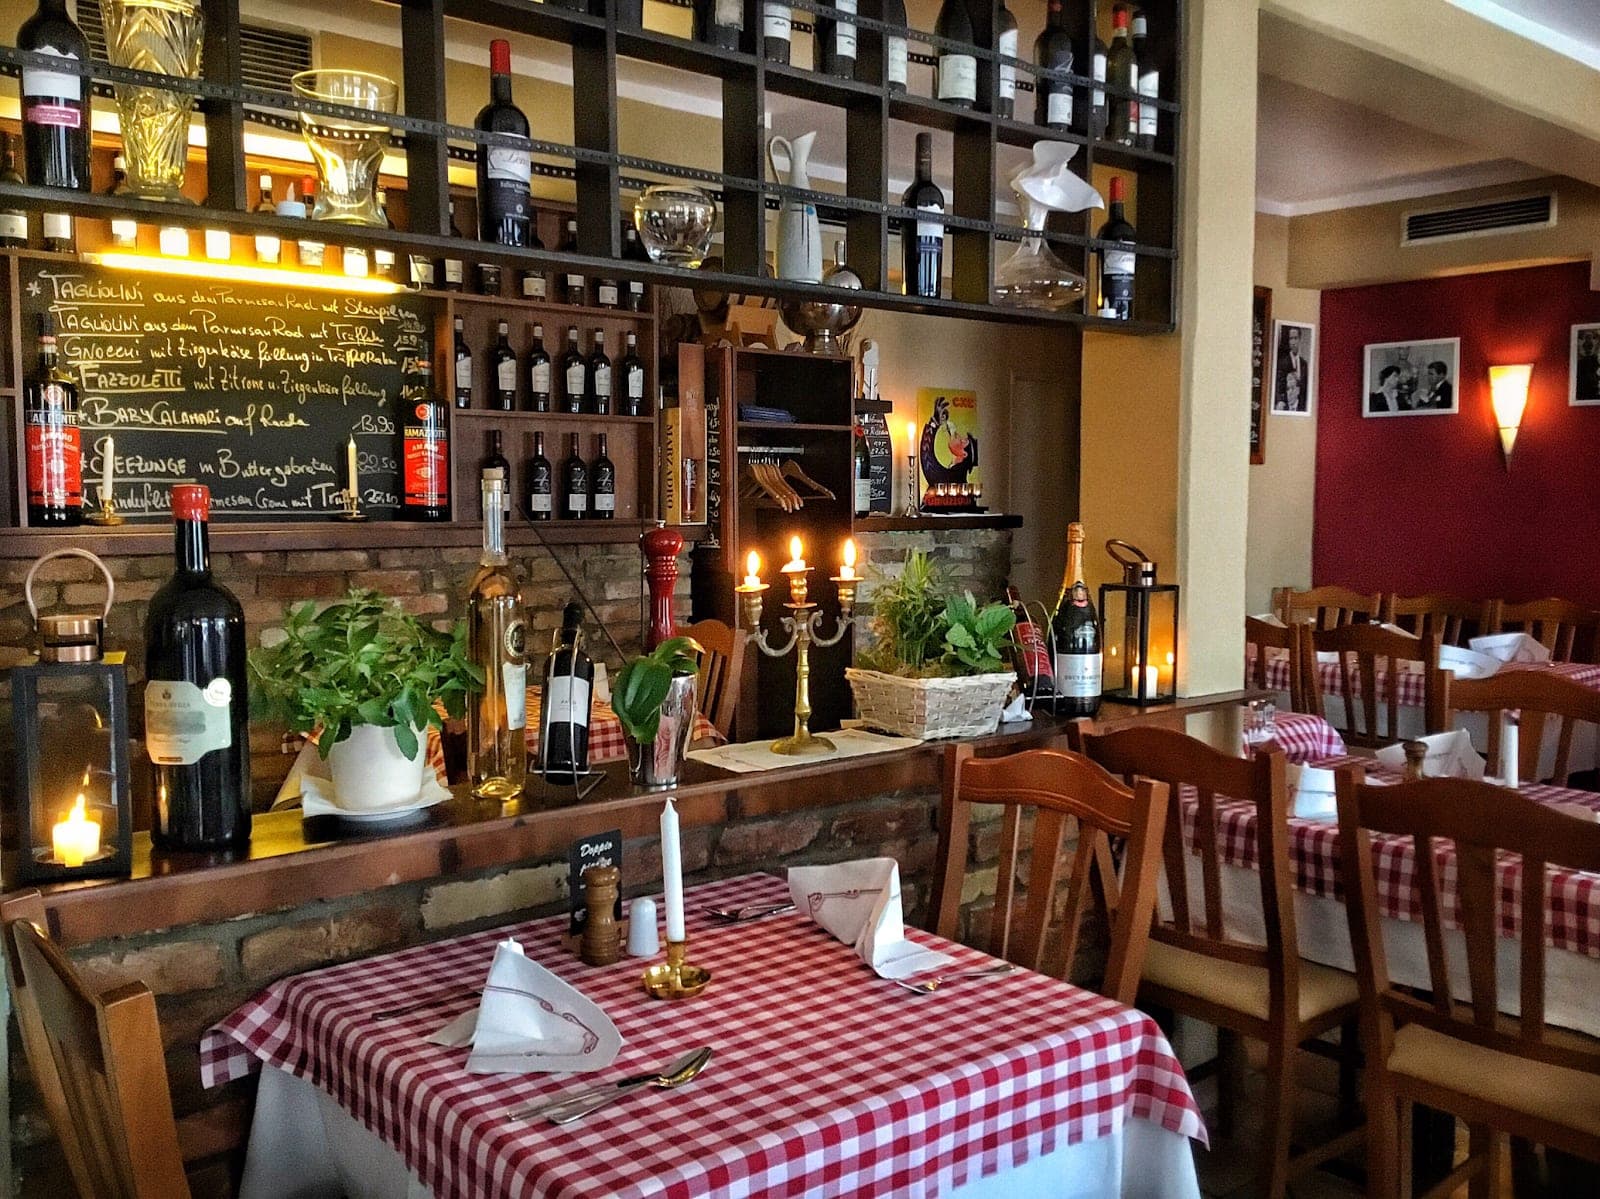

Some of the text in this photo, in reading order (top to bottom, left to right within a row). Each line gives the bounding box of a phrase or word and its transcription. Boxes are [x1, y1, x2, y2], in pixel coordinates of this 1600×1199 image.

[153, 293, 186, 304] aus
[143, 321, 168, 333] aus
[310, 327, 328, 339] mit
[150, 338, 173, 358] mit
[194, 366, 215, 390] mit
[666, 424, 674, 509] MARZADRO
